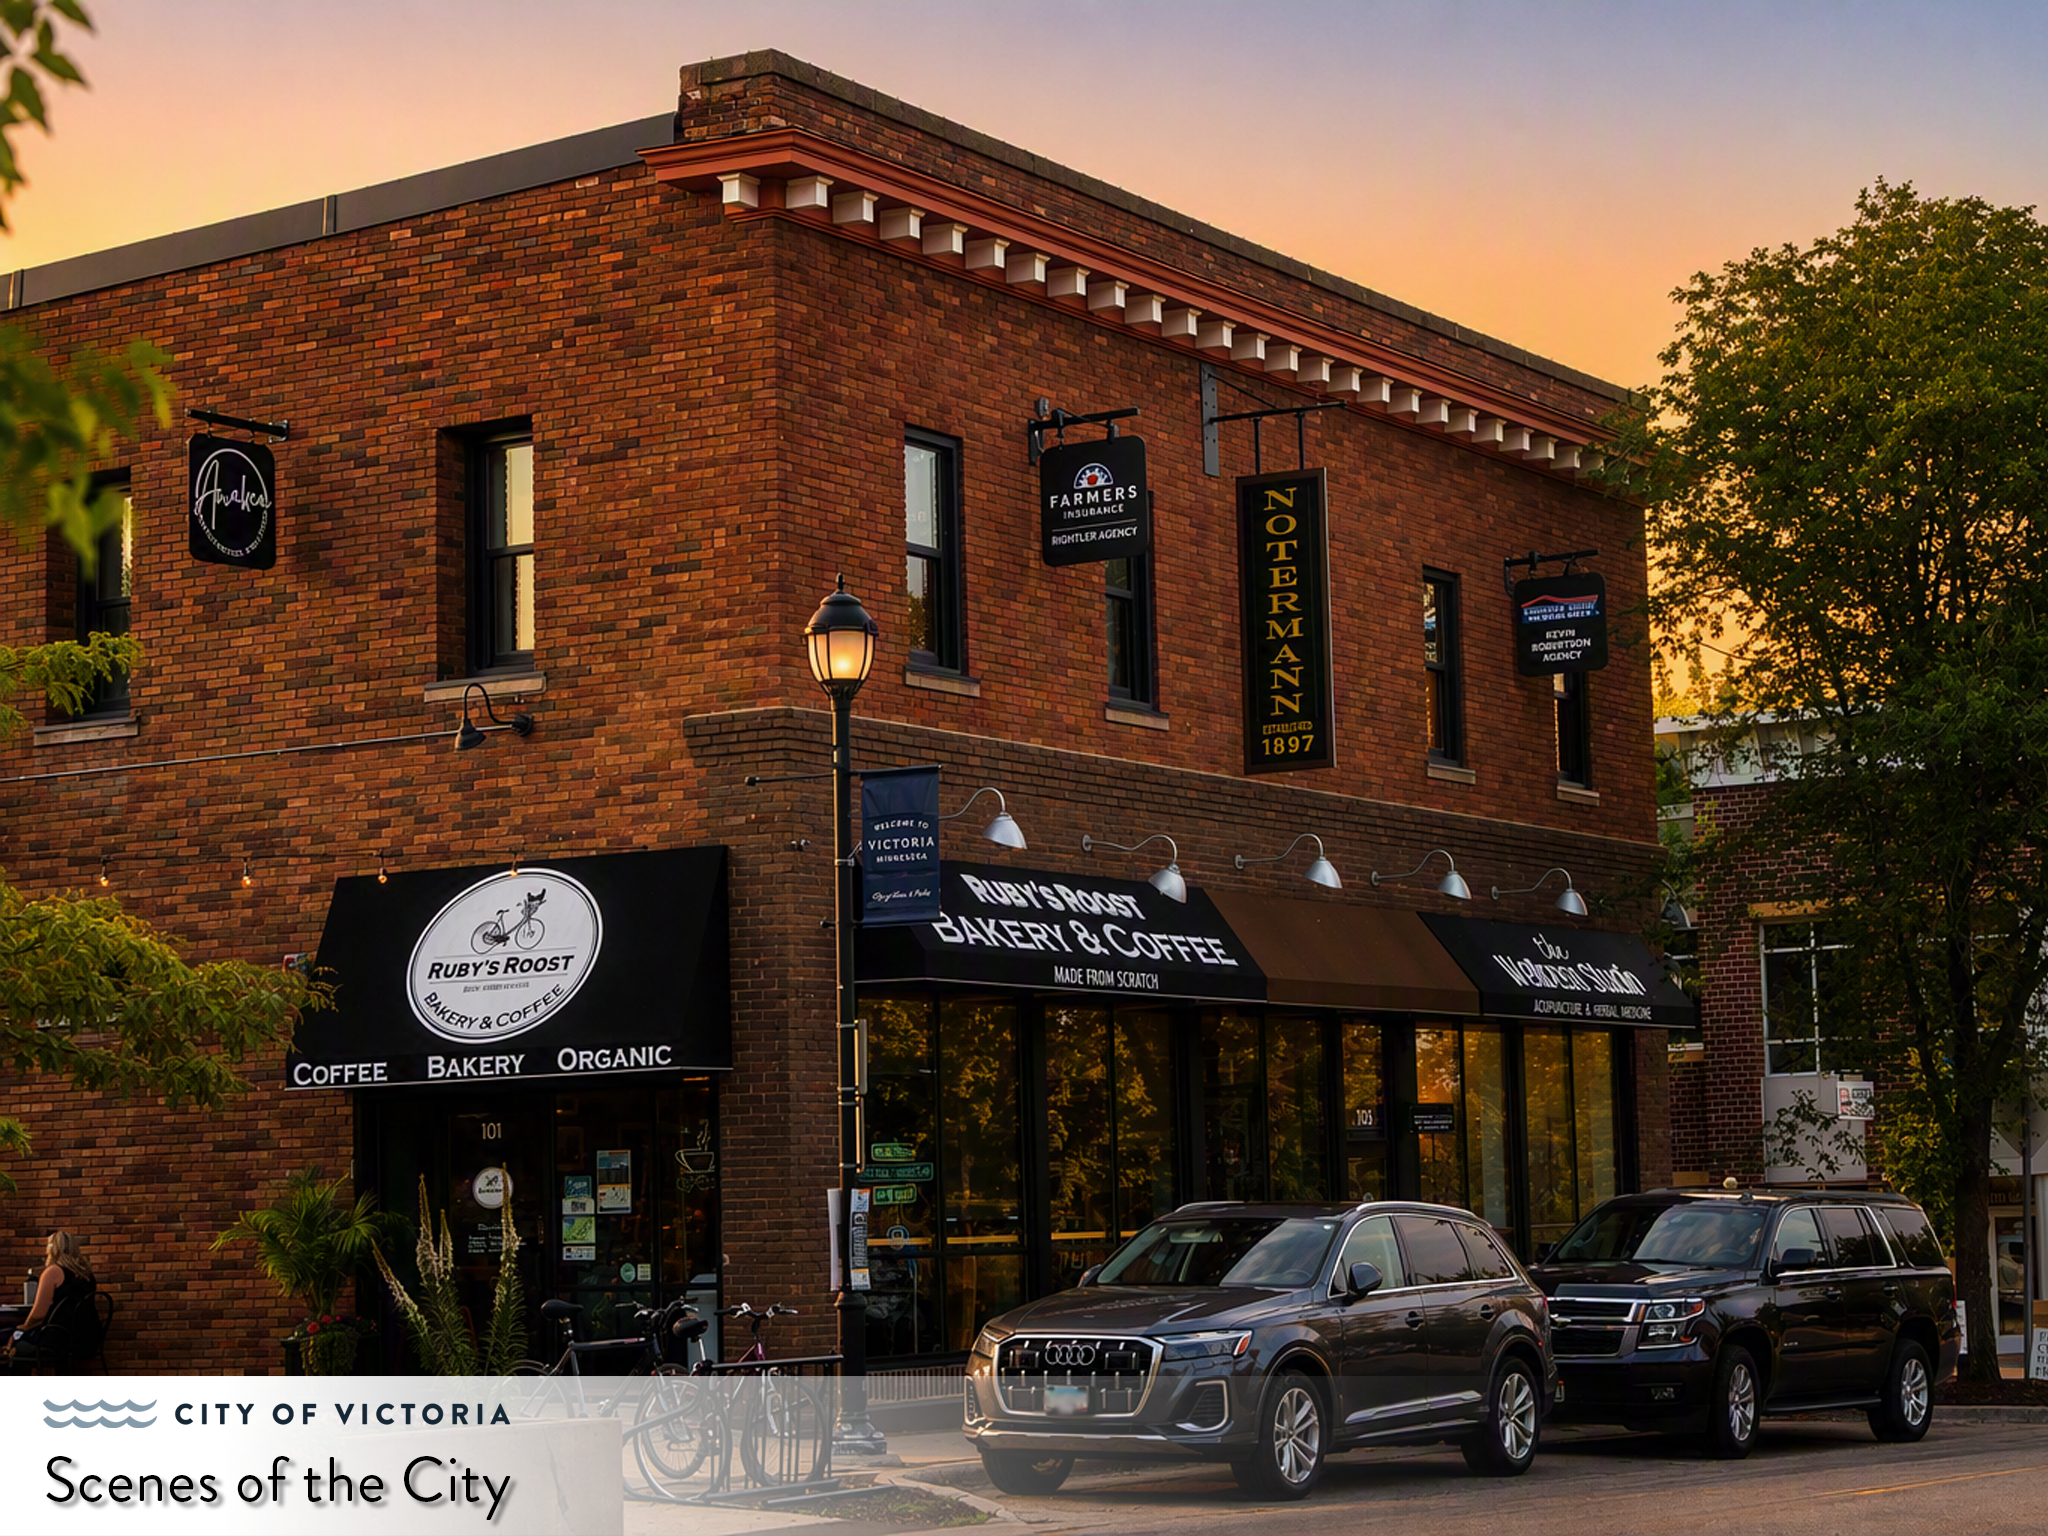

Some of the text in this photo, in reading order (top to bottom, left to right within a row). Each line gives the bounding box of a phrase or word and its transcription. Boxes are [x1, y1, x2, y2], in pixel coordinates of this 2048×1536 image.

[1050, 485, 1137, 508] FARMERS
[1263, 487, 1304, 716] NOTERMANN
[1262, 735, 1314, 755] 1897
[868, 836, 935, 850] VICTORIA
[960, 873, 1146, 921] RUBY'S ROOST
[931, 911, 1239, 967] BAKERY & COFFEE
[427, 955, 575, 980] RUBY'S ROOST
[1054, 966, 1159, 990] MADE FROM SCRATCH
[424, 984, 565, 1030] BAKERY & COFFEE
[293, 1044, 673, 1086] COFFEE BAKERY ORGANIC
[482, 1122, 502, 1139] 101
